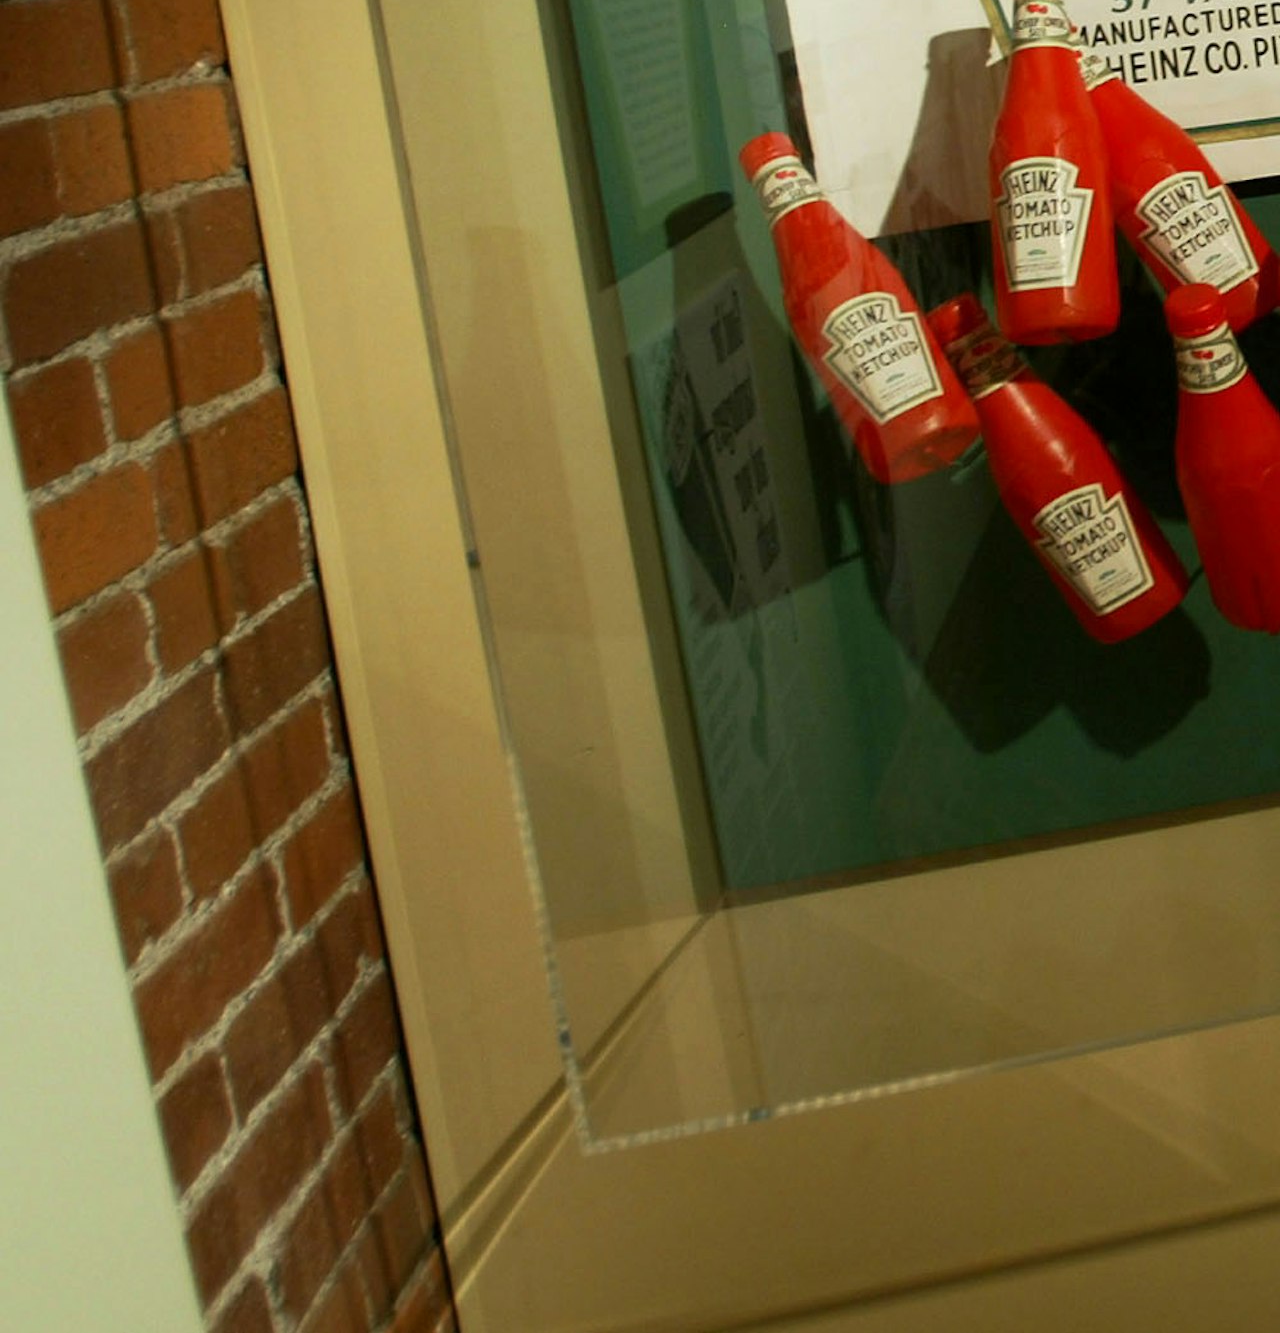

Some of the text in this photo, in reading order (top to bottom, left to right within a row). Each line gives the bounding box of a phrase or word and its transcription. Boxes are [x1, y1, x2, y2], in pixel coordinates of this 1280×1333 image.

[1106, 45, 1198, 84] HEINZ
[1205, 40, 1248, 74] CO.
[1009, 171, 1060, 197] HEINZ
[1150, 183, 1198, 223] HEINZ
[1005, 198, 1071, 221] TOMATO
[1159, 202, 1219, 245] TOMATO
[1169, 218, 1230, 265] KETCHUP
[835, 303, 888, 340] HEINZ
[843, 324, 908, 363] TOMATO
[852, 341, 919, 383] KETCHUP
[1046, 498, 1097, 538] HEINZ
[1056, 516, 1116, 559] TOMATO
